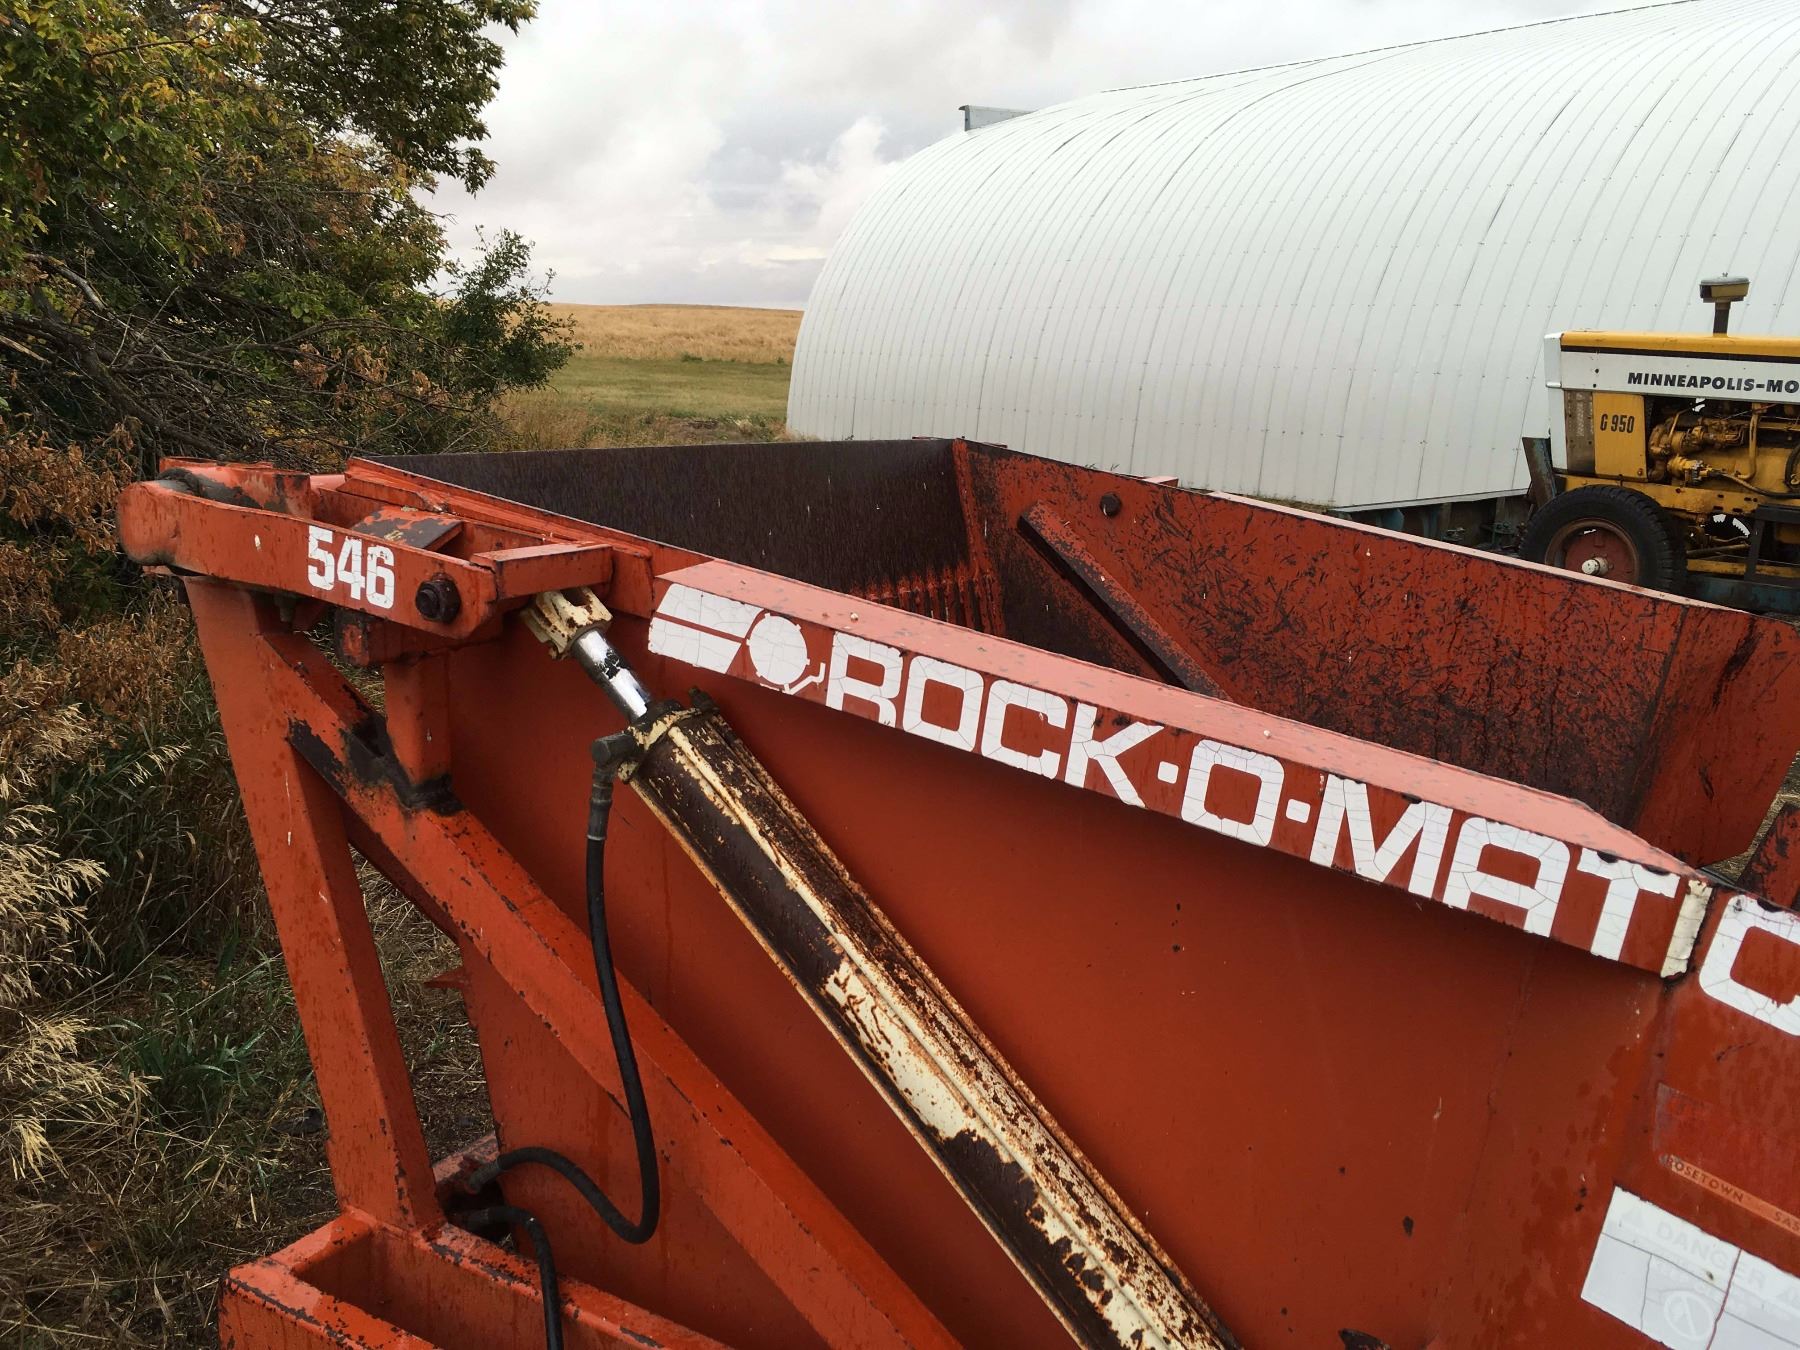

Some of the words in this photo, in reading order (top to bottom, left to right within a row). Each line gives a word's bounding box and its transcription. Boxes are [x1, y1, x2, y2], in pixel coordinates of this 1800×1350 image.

[1627, 372, 1800, 394] MINNEAPOLIS-MO
[1600, 413, 1608, 431] G
[1610, 414, 1635, 434] 950
[307, 525, 395, 609] 546
[1667, 1156, 1744, 1202] ROSETOWN
[1655, 1220, 1768, 1290] DANGER
